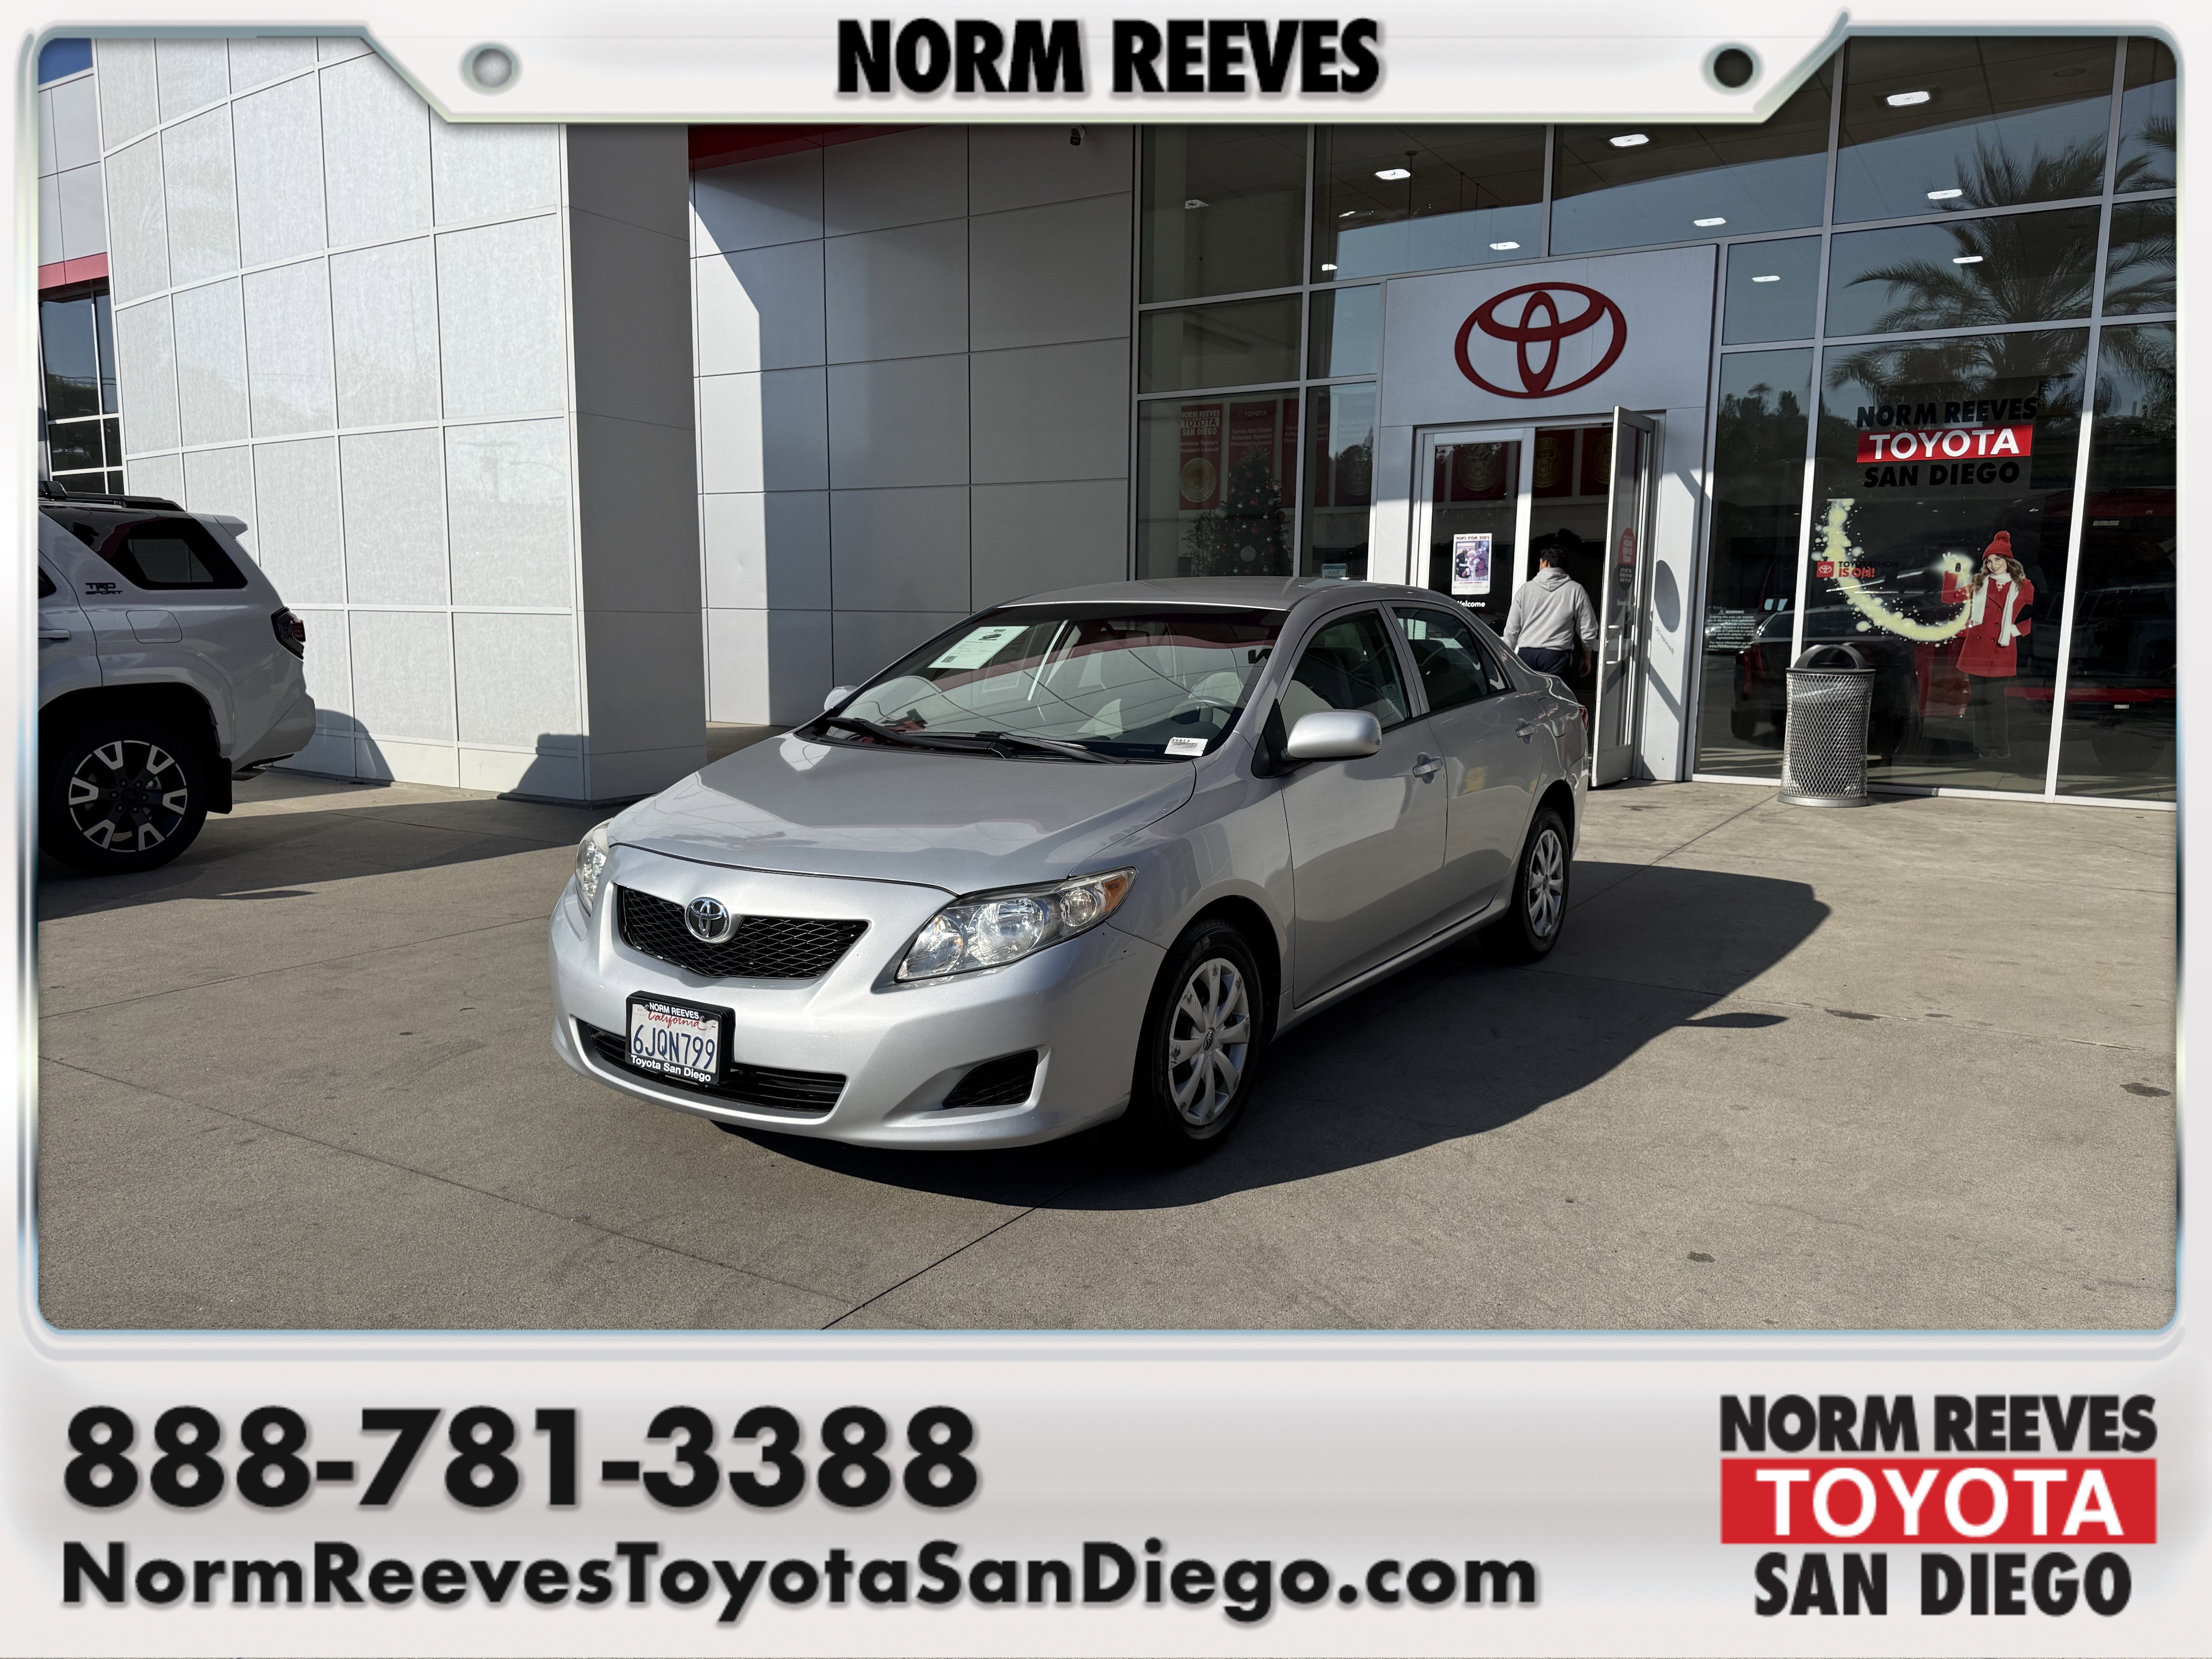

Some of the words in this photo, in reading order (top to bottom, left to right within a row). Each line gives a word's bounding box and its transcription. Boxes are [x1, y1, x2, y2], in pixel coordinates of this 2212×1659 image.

[1857, 403, 1936, 428] NORM
[1944, 397, 2037, 423] REEVES
[1182, 428, 1195, 436] SAN
[1197, 427, 1217, 436] DIEGO
[1183, 418, 1216, 427] TOYOTA
[1869, 428, 2020, 460] TOYOTA
[1863, 465, 1918, 488] SAN
[1929, 462, 2019, 485] DIEGO
[1839, 568, 1849, 577] IS
[1851, 568, 1875, 578] ON!
[85, 582, 116, 591] TRD
[648, 1011, 707, 1030] California
[649, 1002, 670, 1014] NORM
[671, 1007, 699, 1020] REEVES
[634, 1024, 715, 1070] 6JQN799
[631, 1054, 661, 1070] Toyota
[663, 1062, 681, 1075] San
[684, 1067, 711, 1082] Diego
